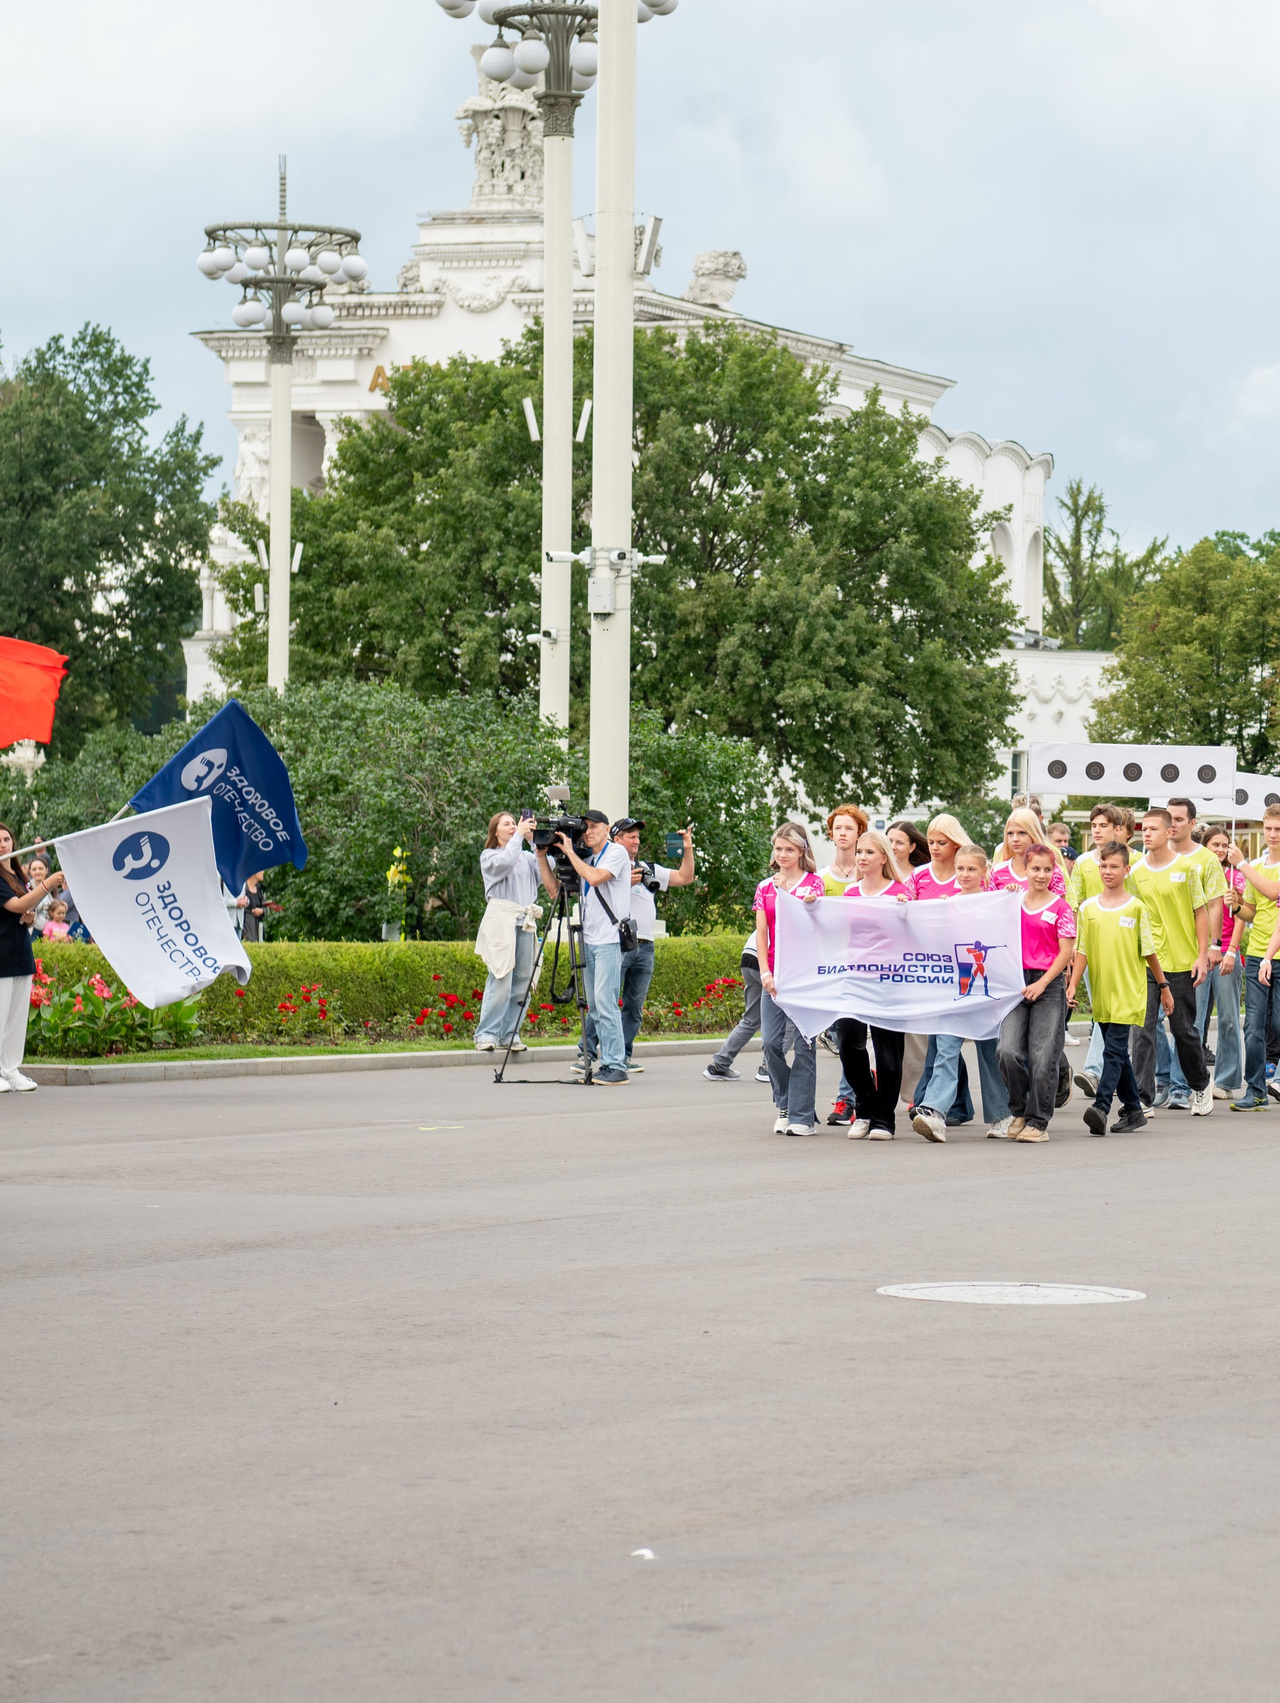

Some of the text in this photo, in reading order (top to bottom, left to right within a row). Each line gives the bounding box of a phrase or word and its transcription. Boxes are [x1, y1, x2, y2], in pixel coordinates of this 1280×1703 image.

[213, 782, 274, 851] ОТЕЧЕСТВО
[226, 765, 290, 843] ЗДОРОВОЕ
[902, 952, 953, 963] СОЮЗ
[879, 973, 954, 985] РОССИИ
